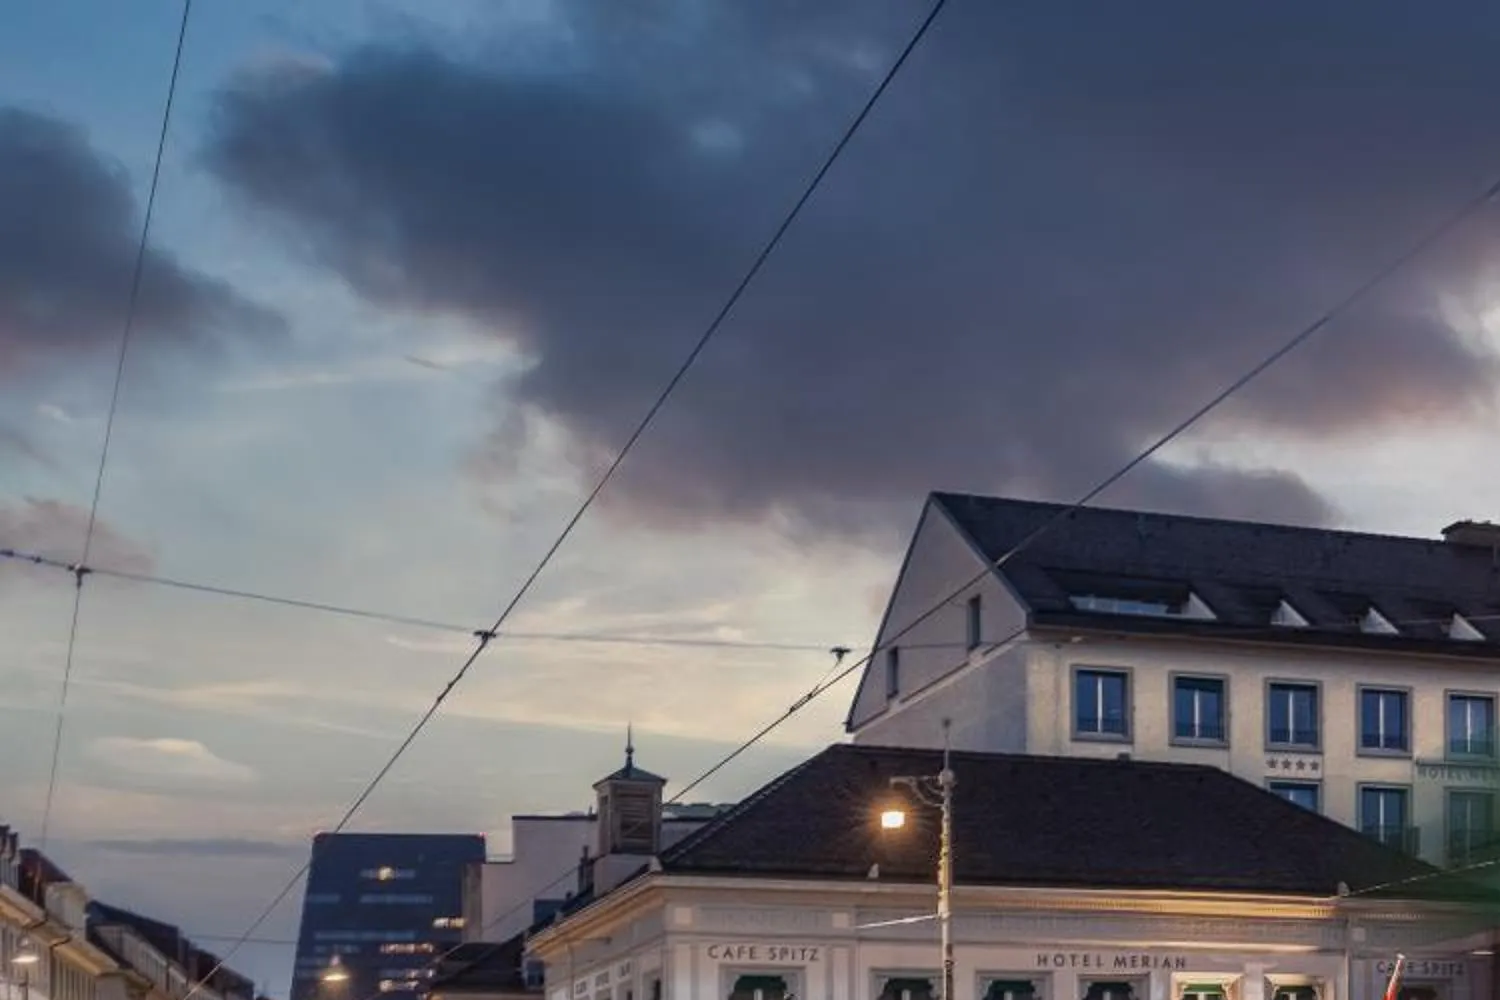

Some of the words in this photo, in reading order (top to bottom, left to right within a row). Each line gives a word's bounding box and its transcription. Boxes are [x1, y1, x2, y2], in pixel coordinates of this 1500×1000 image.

[707, 944, 758, 960] CAFE
[768, 946, 820, 962] SPITZ
[1036, 953, 1105, 968] HOTEL
[1113, 955, 1187, 970] MERIAN
